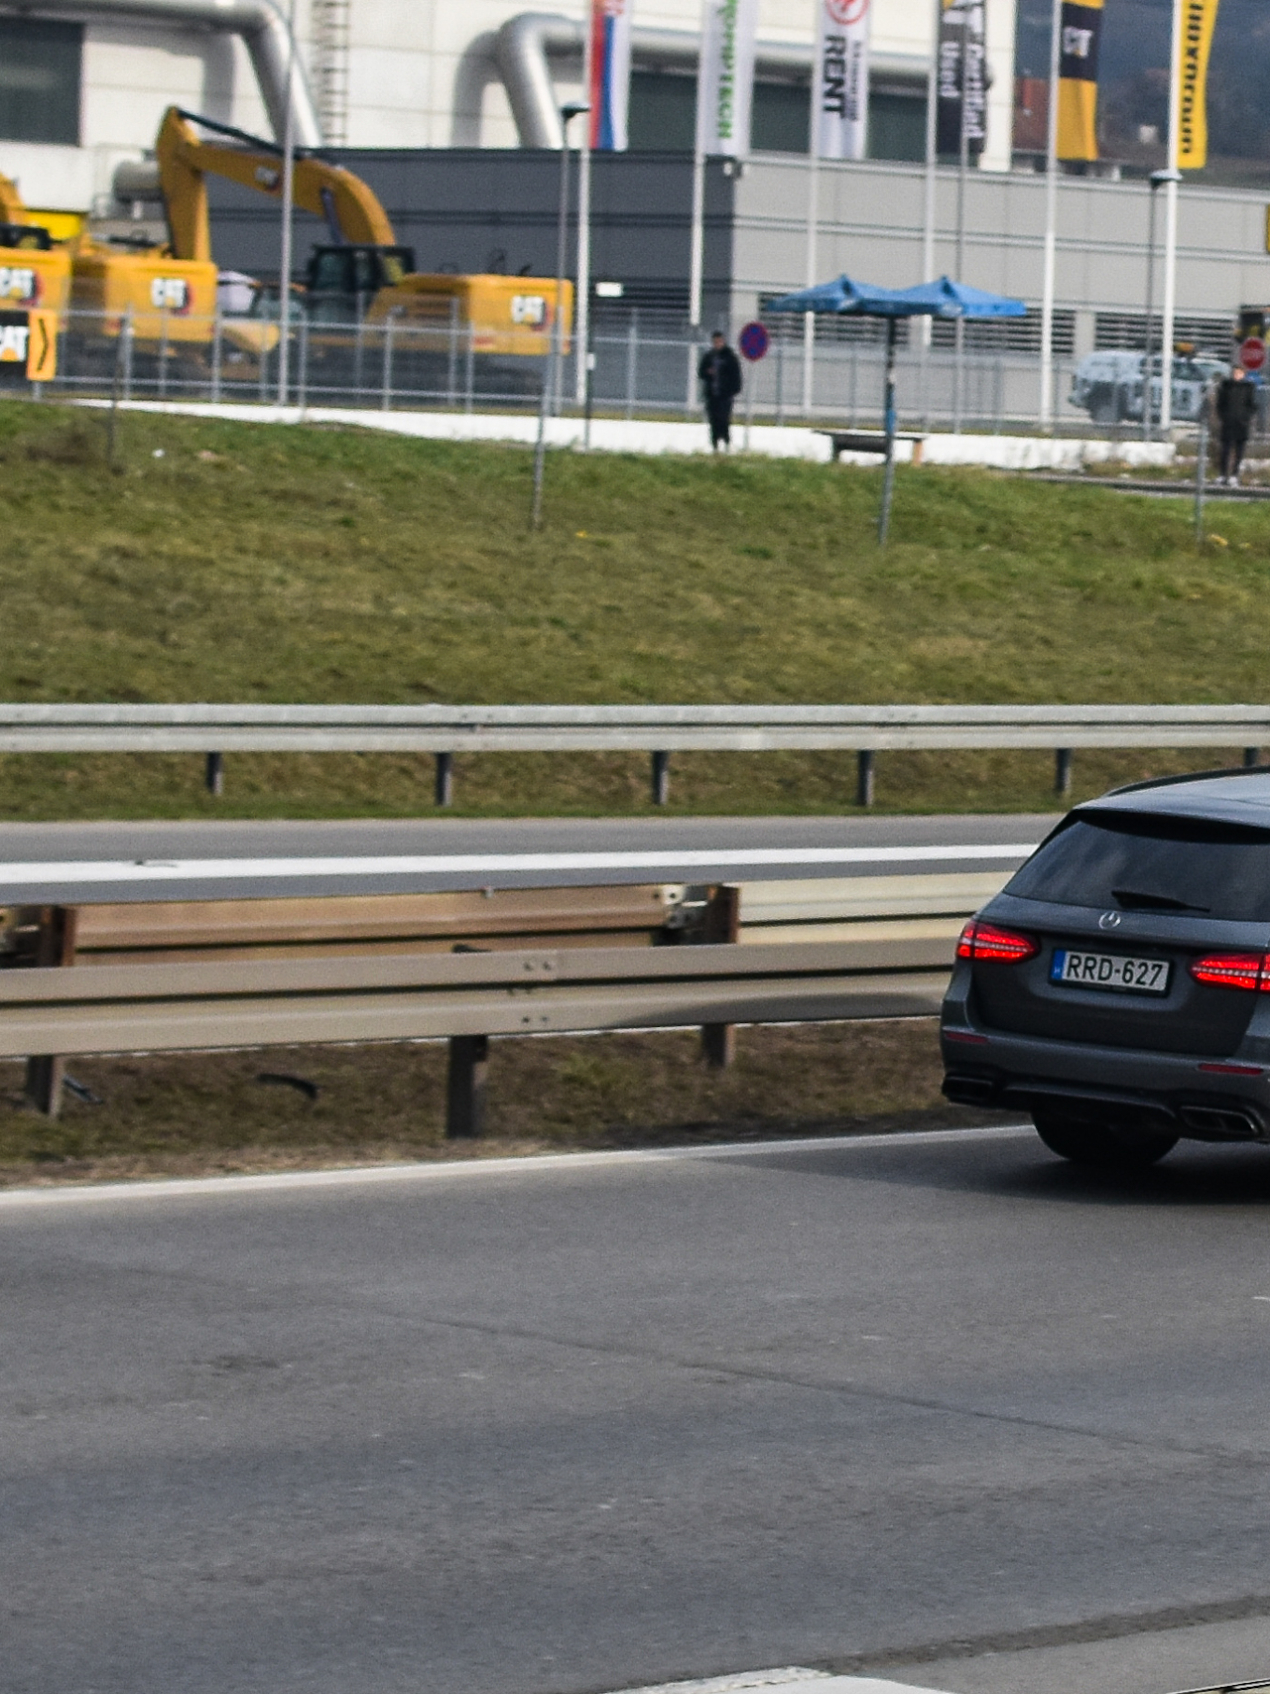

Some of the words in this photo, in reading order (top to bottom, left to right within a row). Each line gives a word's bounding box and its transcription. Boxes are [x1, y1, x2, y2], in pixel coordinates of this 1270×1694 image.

[824, 35, 846, 119] RENT
[152, 278, 187, 308] CAT
[512, 296, 544, 323] CAT
[1067, 955, 1163, 987] RRD-627
